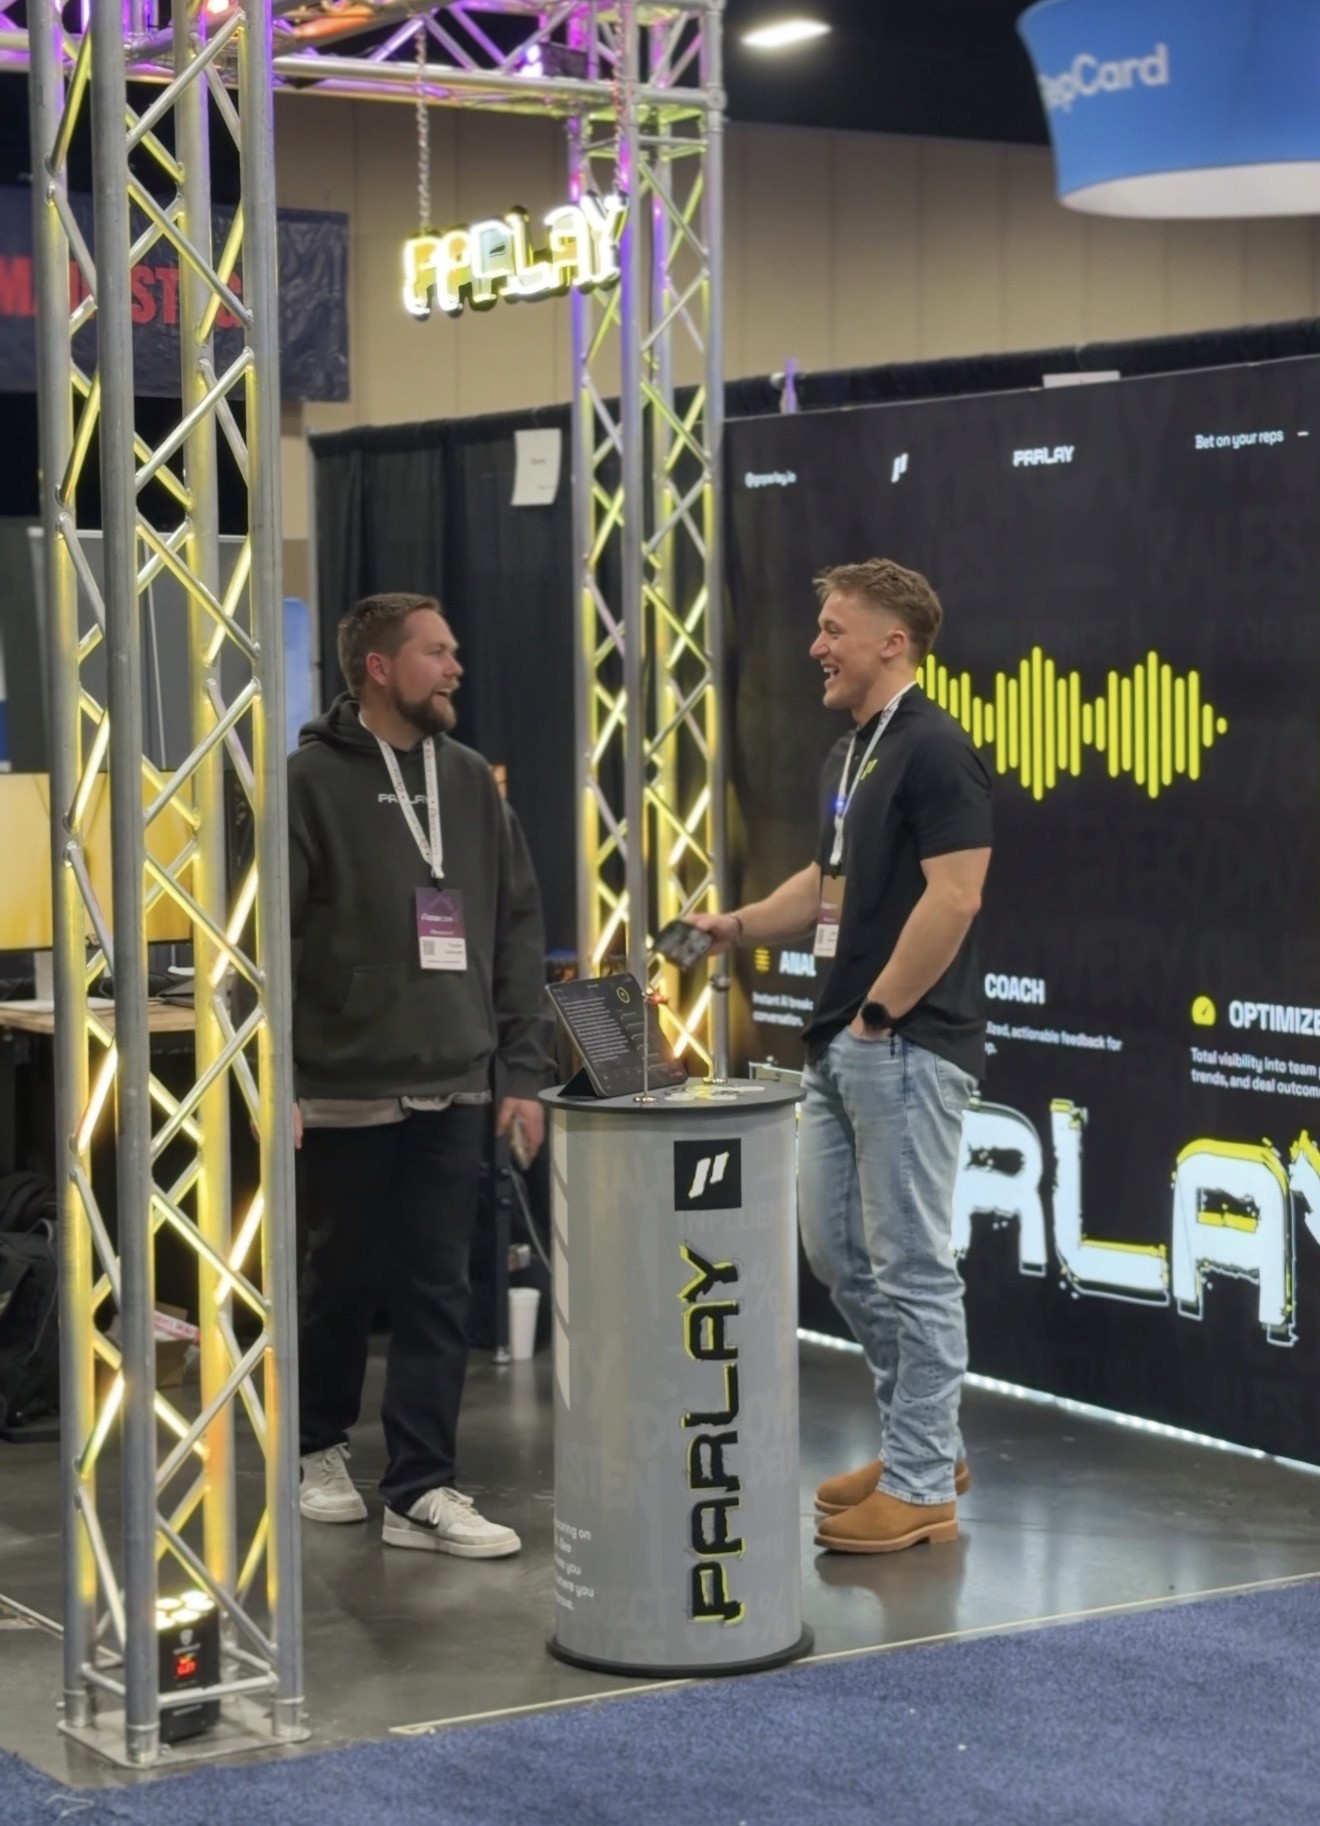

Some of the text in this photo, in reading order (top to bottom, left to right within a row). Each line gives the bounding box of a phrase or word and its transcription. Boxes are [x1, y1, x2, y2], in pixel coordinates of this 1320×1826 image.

[1195, 430, 1284, 449] Bet on your reps
[1013, 446, 1074, 466] PARLAY
[779, 950, 817, 977] ANAL
[984, 973, 1046, 1005] COACH
[1229, 1000, 1320, 1036] OPTIMIZE
[1011, 1026, 1060, 1044] actionable
[1061, 1031, 1106, 1049] feedback
[1106, 1035, 1123, 1051] for
[1190, 1047, 1317, 1077] Total visibility into team
[1191, 1069, 1320, 1099] trends, and deal outcom
[677, 1243, 747, 1627] PARLAY
